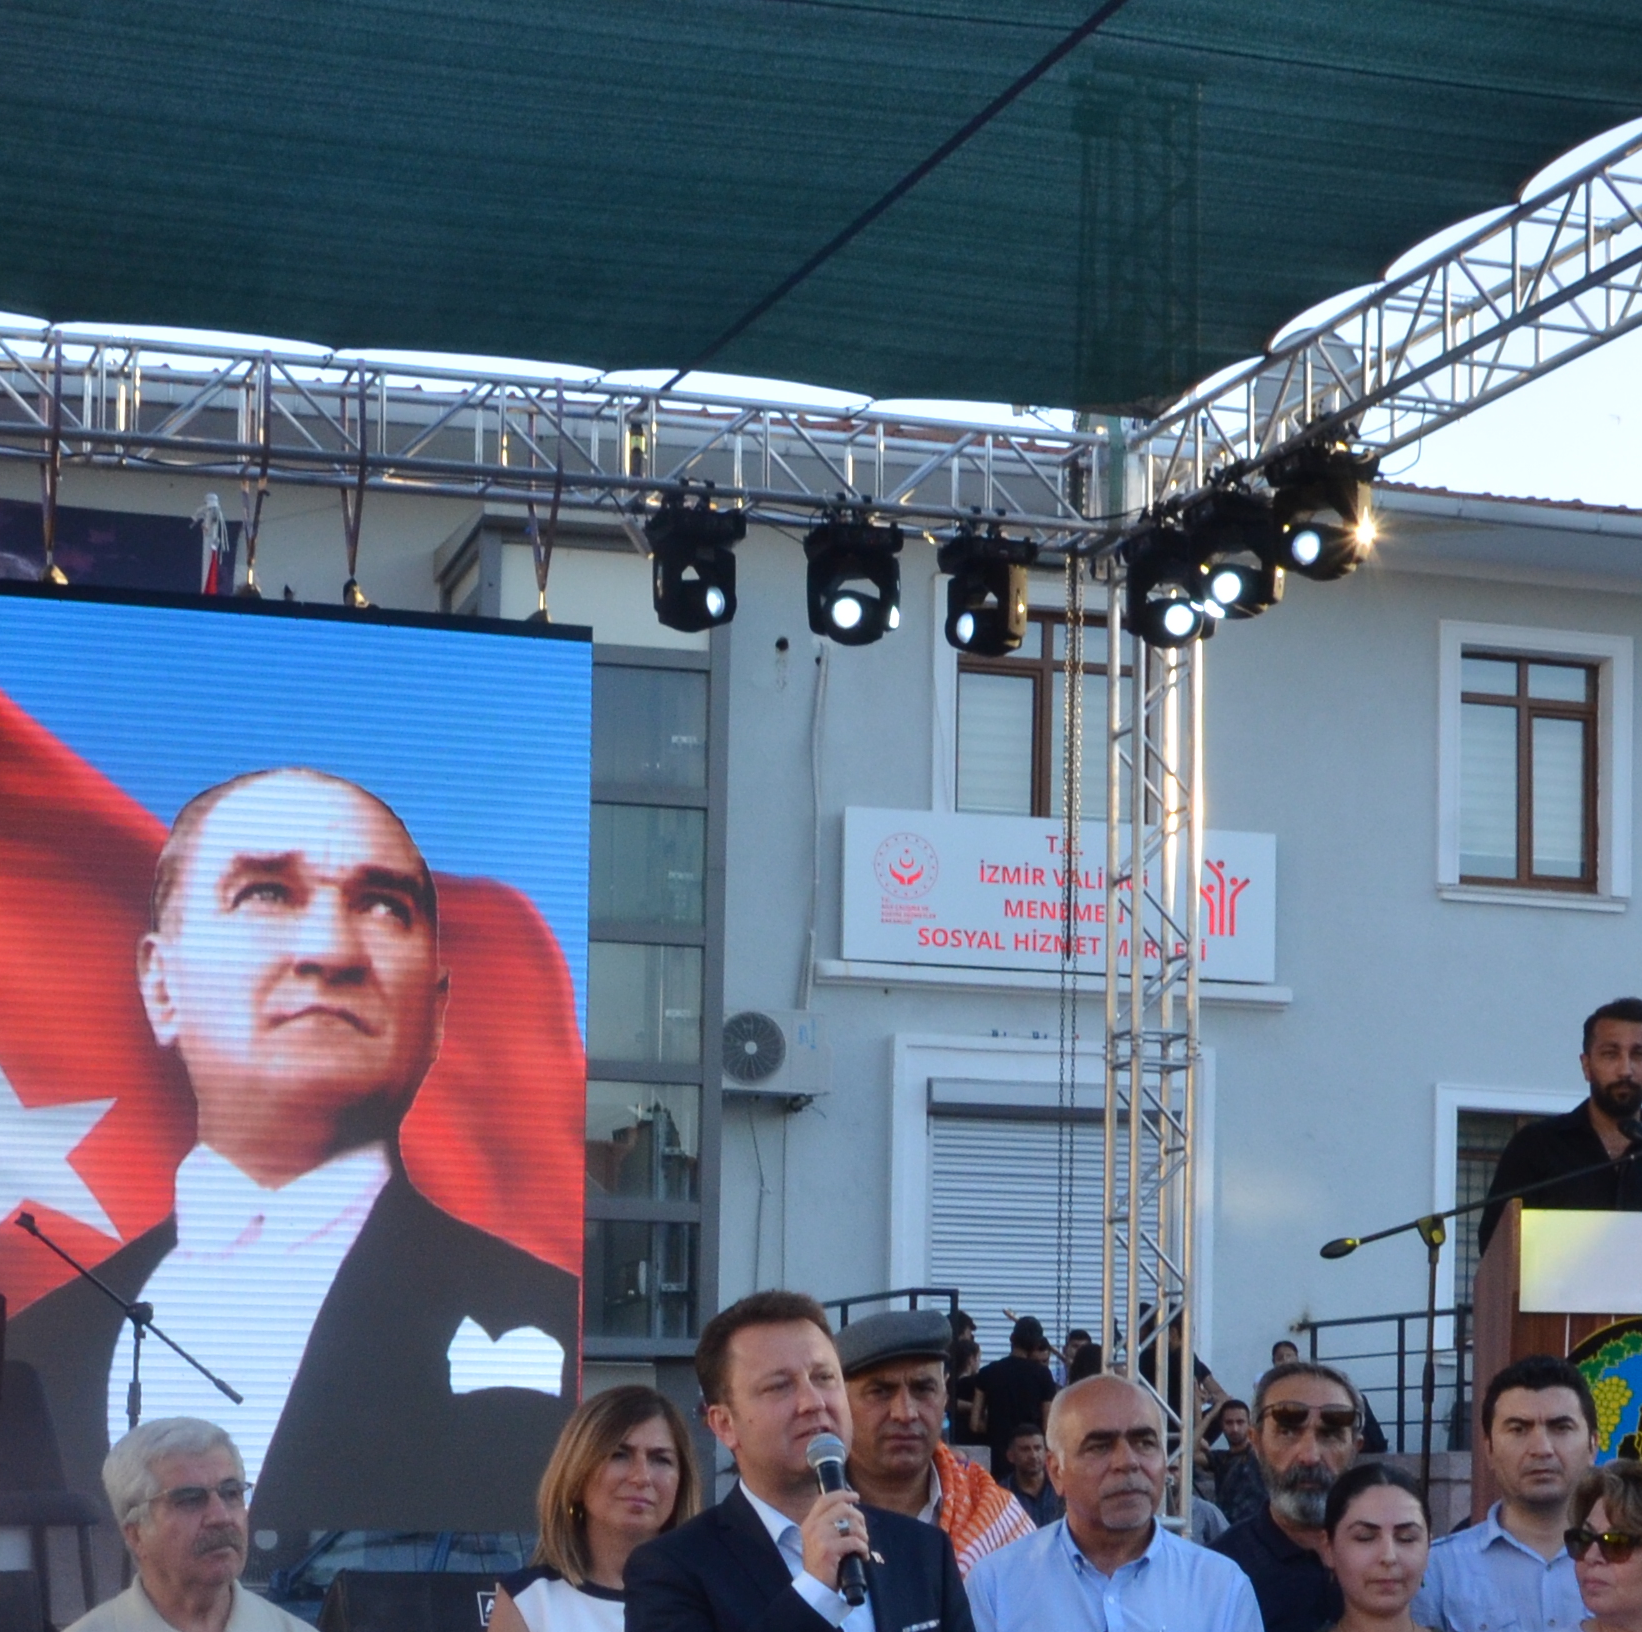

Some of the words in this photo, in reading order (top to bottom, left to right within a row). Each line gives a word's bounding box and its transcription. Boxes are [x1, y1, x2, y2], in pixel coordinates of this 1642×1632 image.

[979, 859, 1046, 887] İZMİR
[1052, 866, 1149, 891] VALİİİ
[917, 927, 1006, 950] SOSYAL
[1013, 929, 1101, 955] HİZMET
